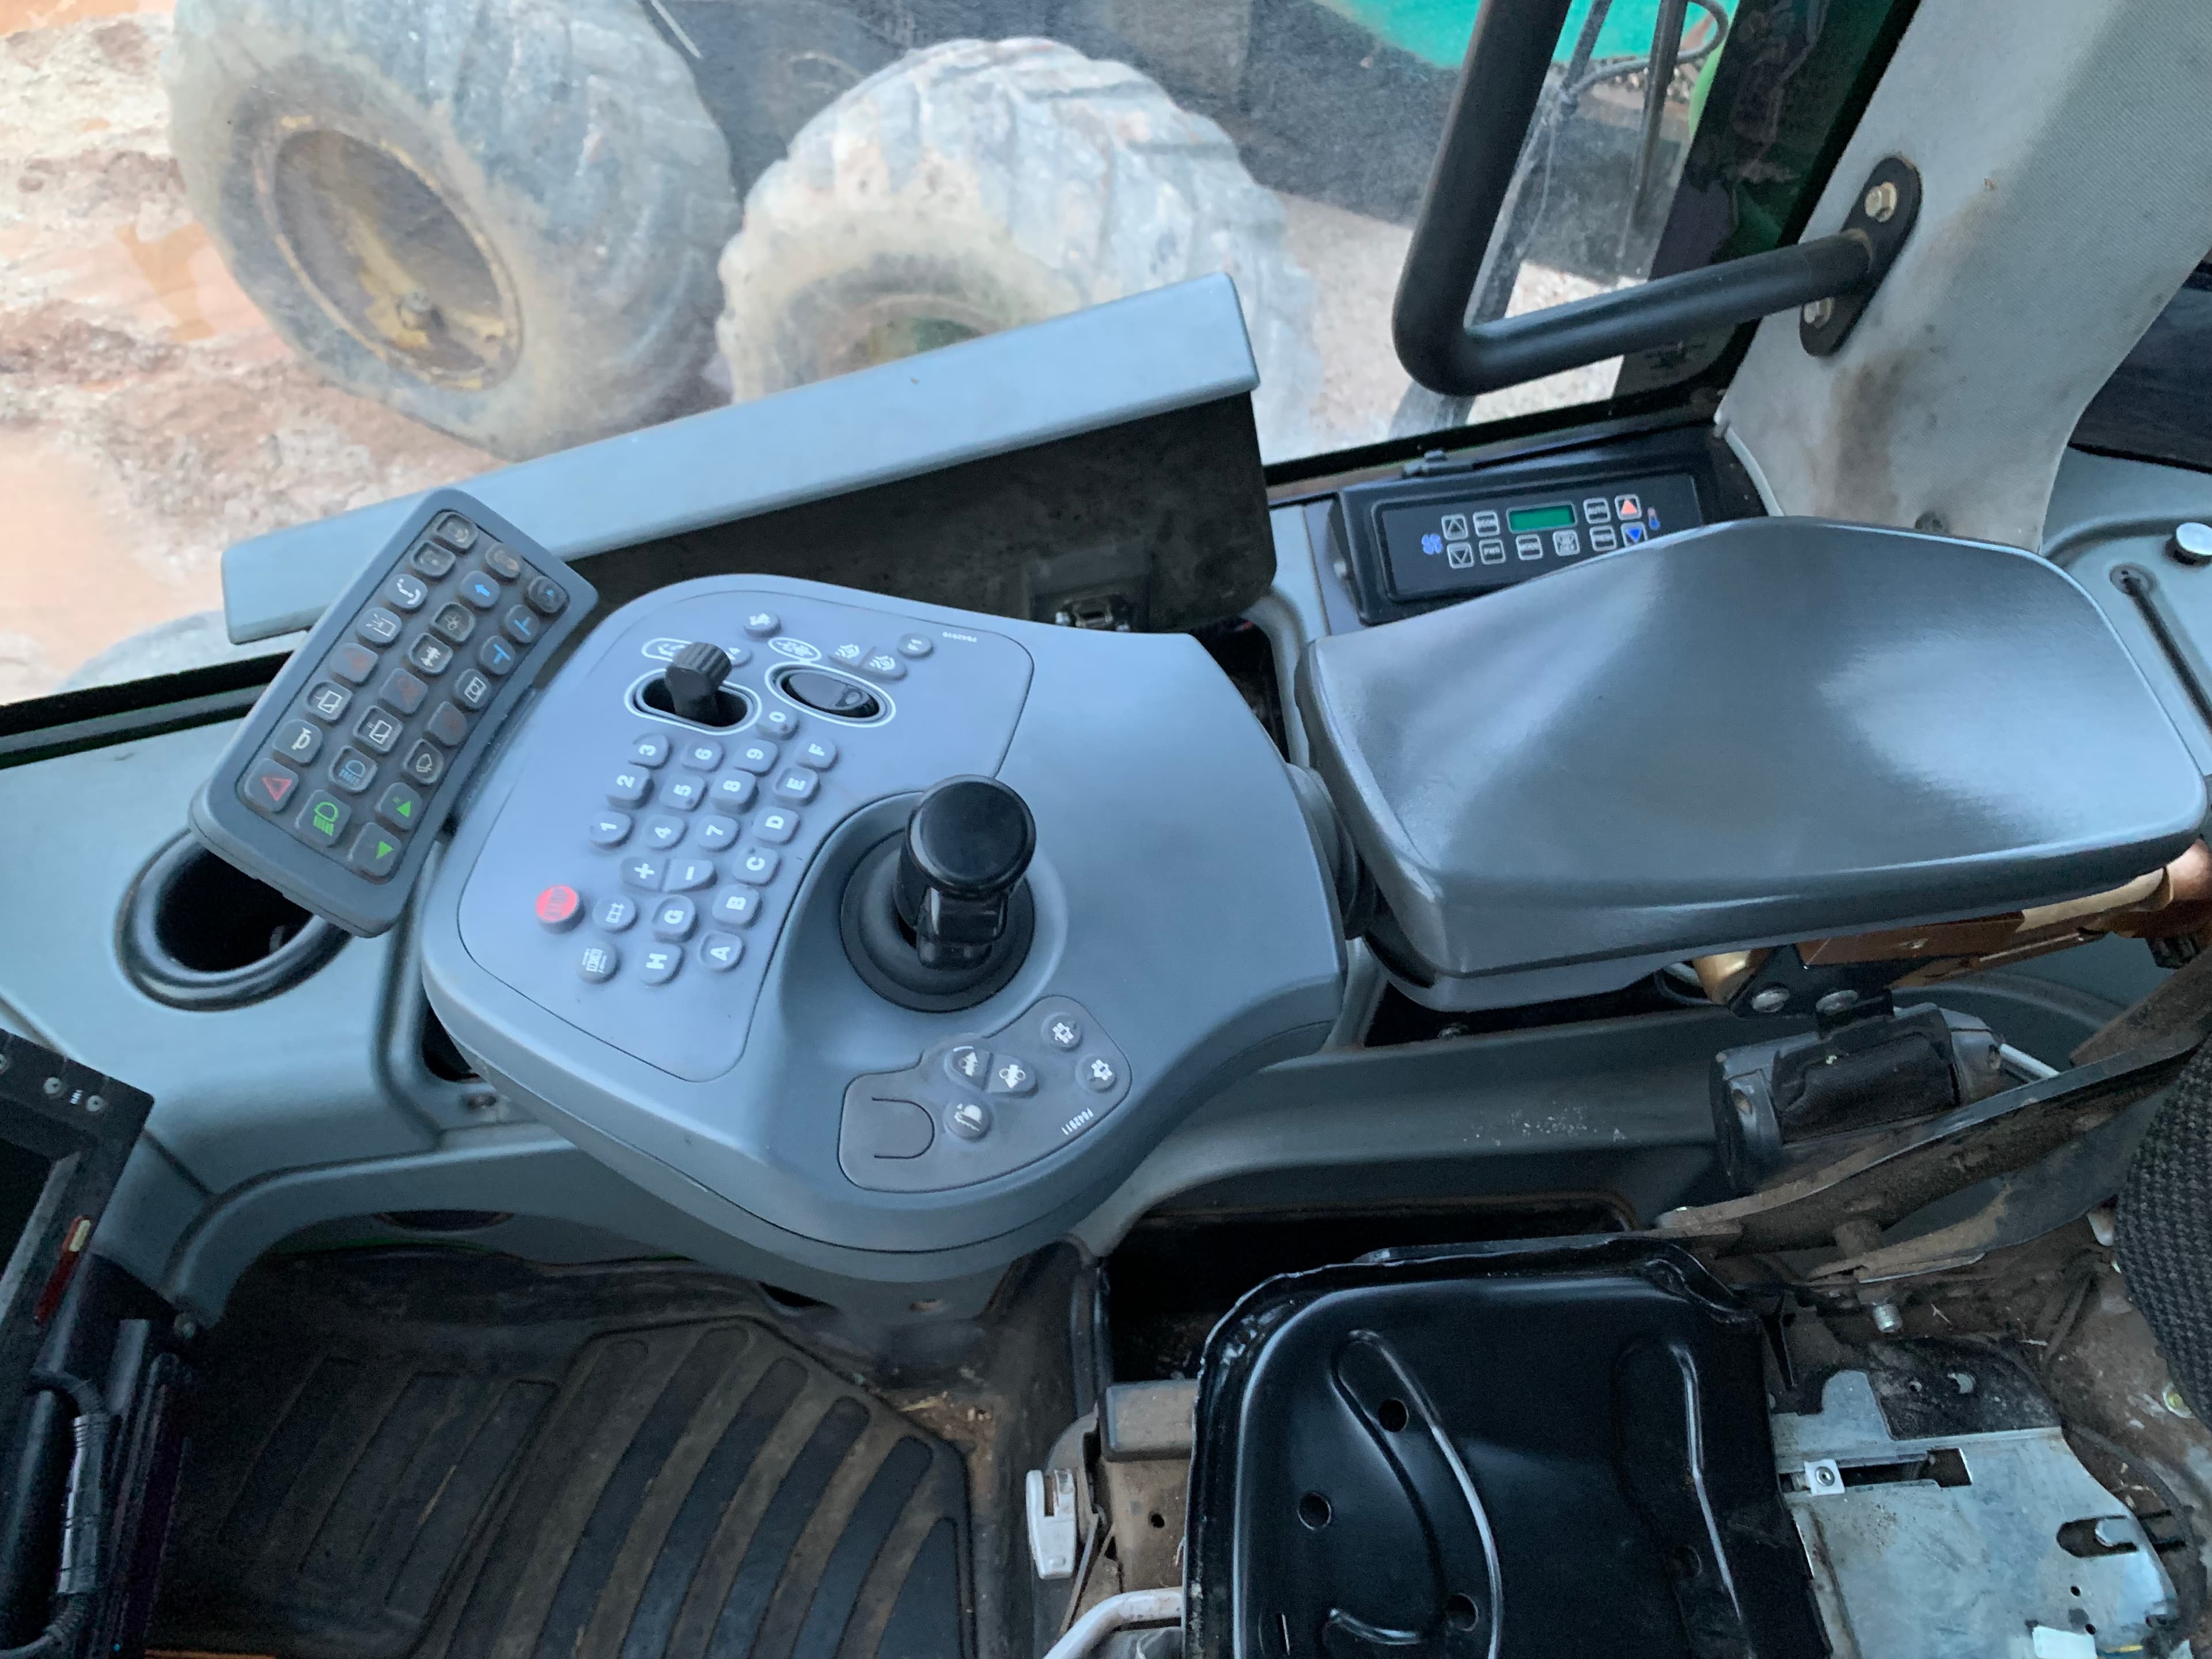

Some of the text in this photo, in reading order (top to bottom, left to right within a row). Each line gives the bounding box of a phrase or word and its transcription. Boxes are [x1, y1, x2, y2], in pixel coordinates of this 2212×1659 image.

[770, 712, 785, 722] 0
[639, 745, 656, 756] 3
[696, 749, 711, 759] 6
[747, 749, 763, 759] 9
[809, 744, 824, 756] F
[617, 775, 634, 787] 2
[724, 781, 740, 791] 8
[787, 778, 805, 790] E
[674, 785, 691, 796] 5
[600, 823, 616, 831] 1
[766, 816, 783, 829] D
[656, 828, 671, 838] 4
[706, 825, 723, 835] 7
[747, 857, 764, 870] C
[726, 897, 745, 910] B
[665, 911, 683, 923] G
[711, 947, 729, 960] A
[646, 954, 666, 969] H
[1061, 1107, 1094, 1137] F042011
